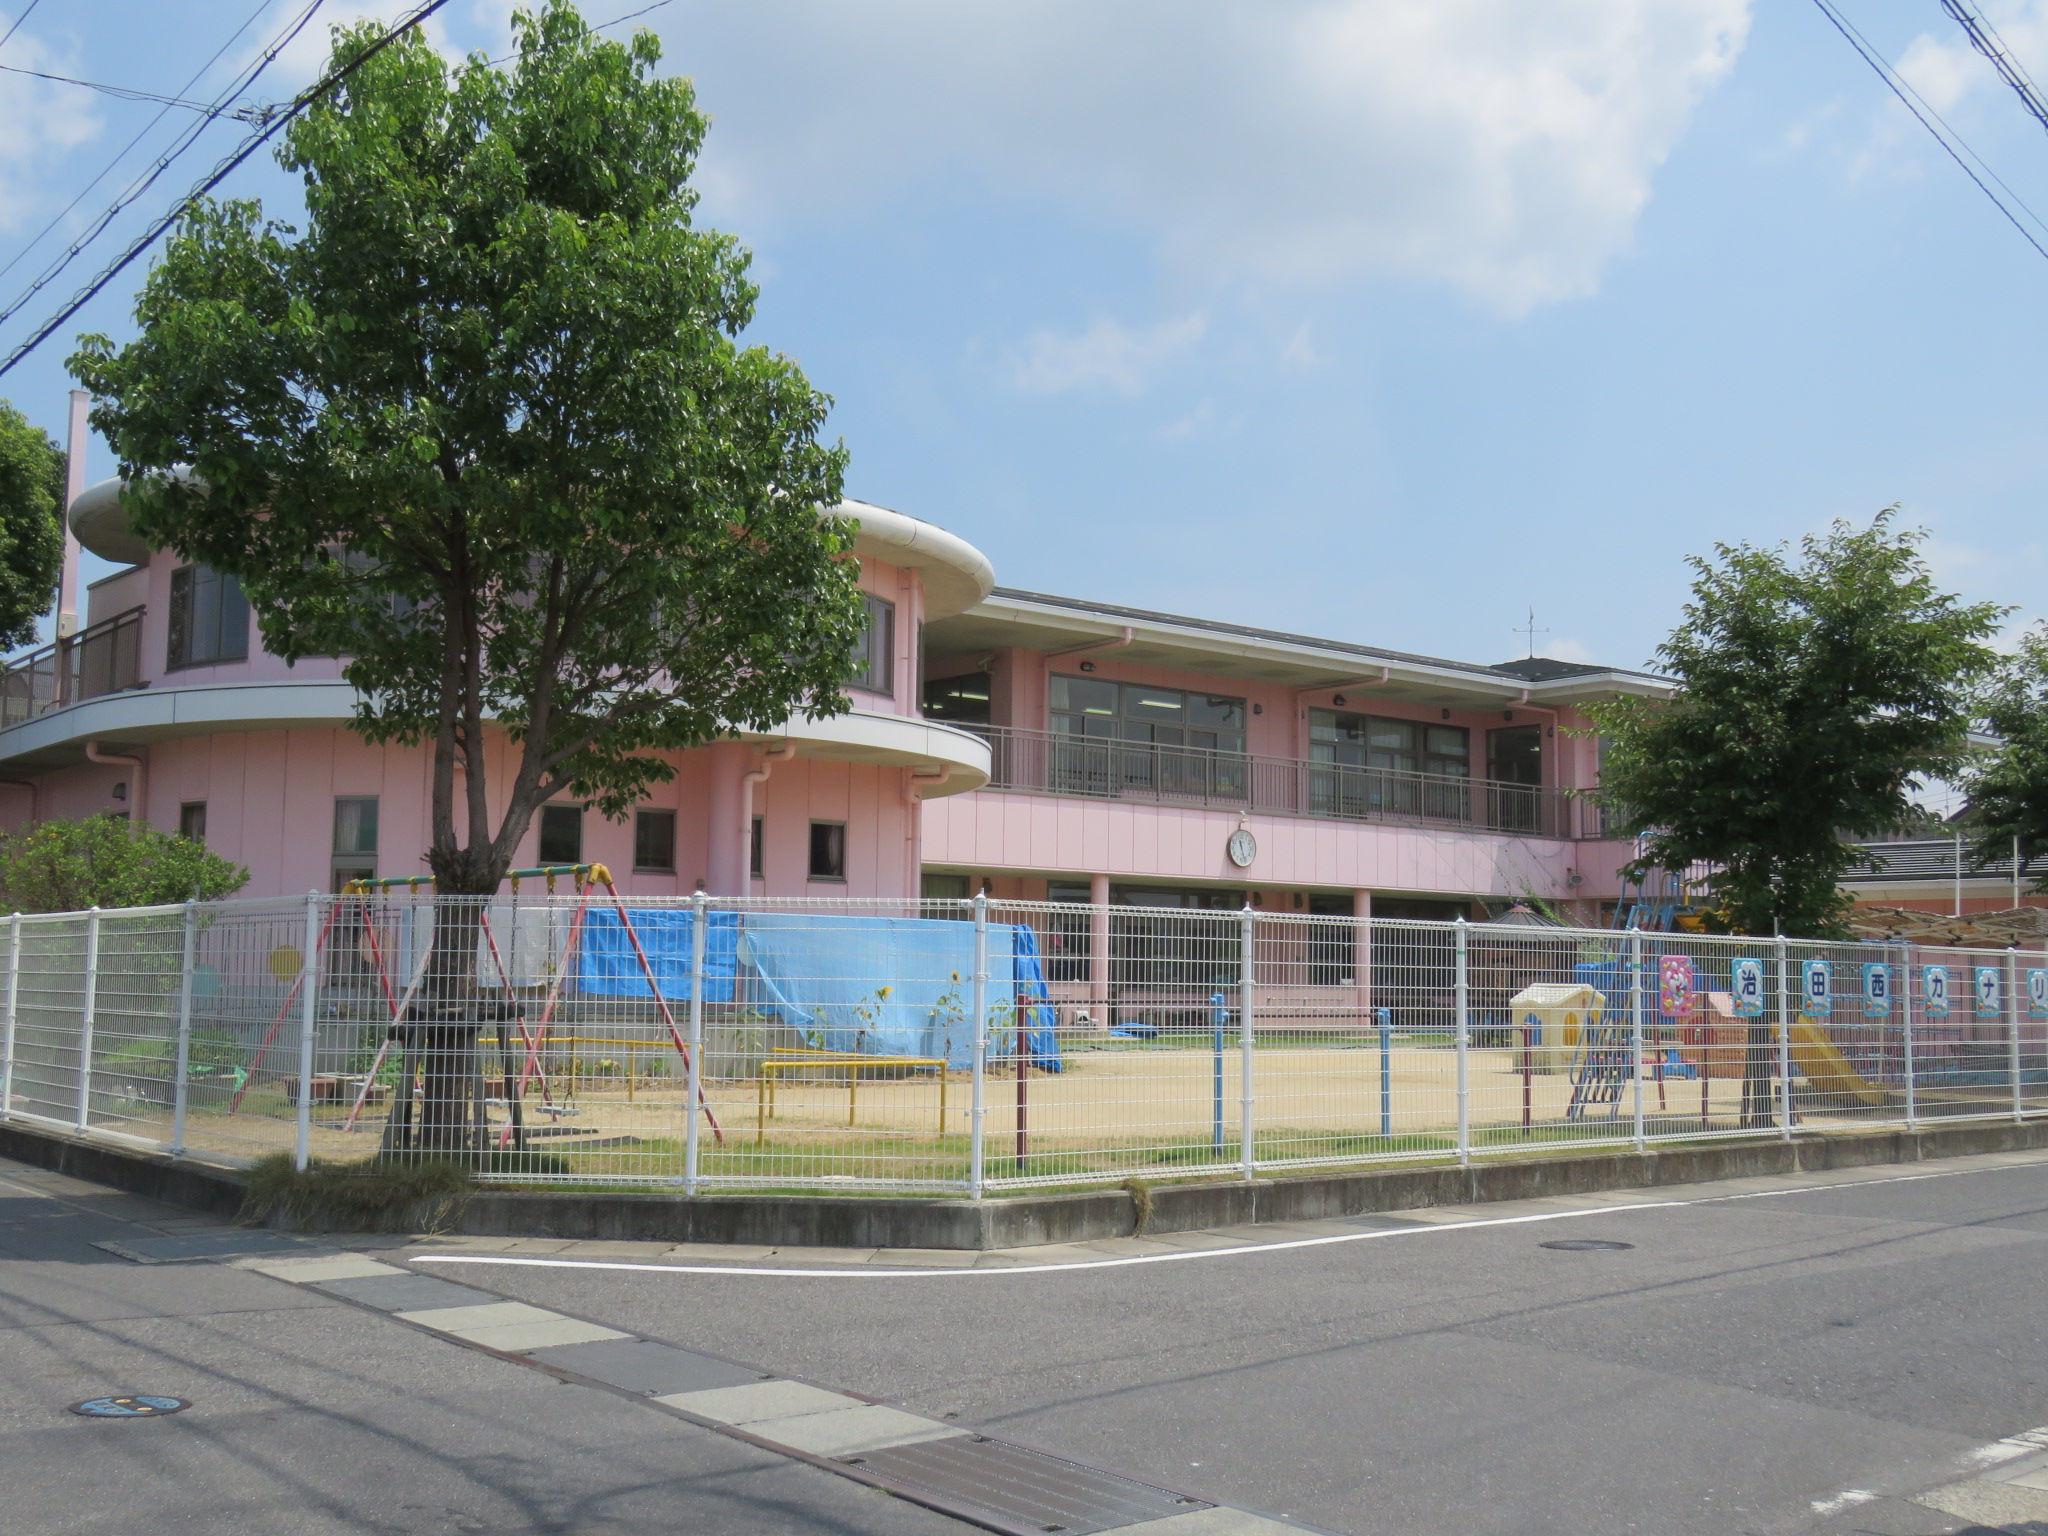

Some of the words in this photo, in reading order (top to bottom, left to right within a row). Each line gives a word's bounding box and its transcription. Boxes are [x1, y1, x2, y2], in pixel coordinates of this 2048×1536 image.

[1742, 969, 1757, 995] 治
[1812, 972, 1825, 996] 田
[1871, 974, 1884, 997] 西
[1932, 975, 1943, 998] カ
[1983, 977, 1995, 999] ナ
